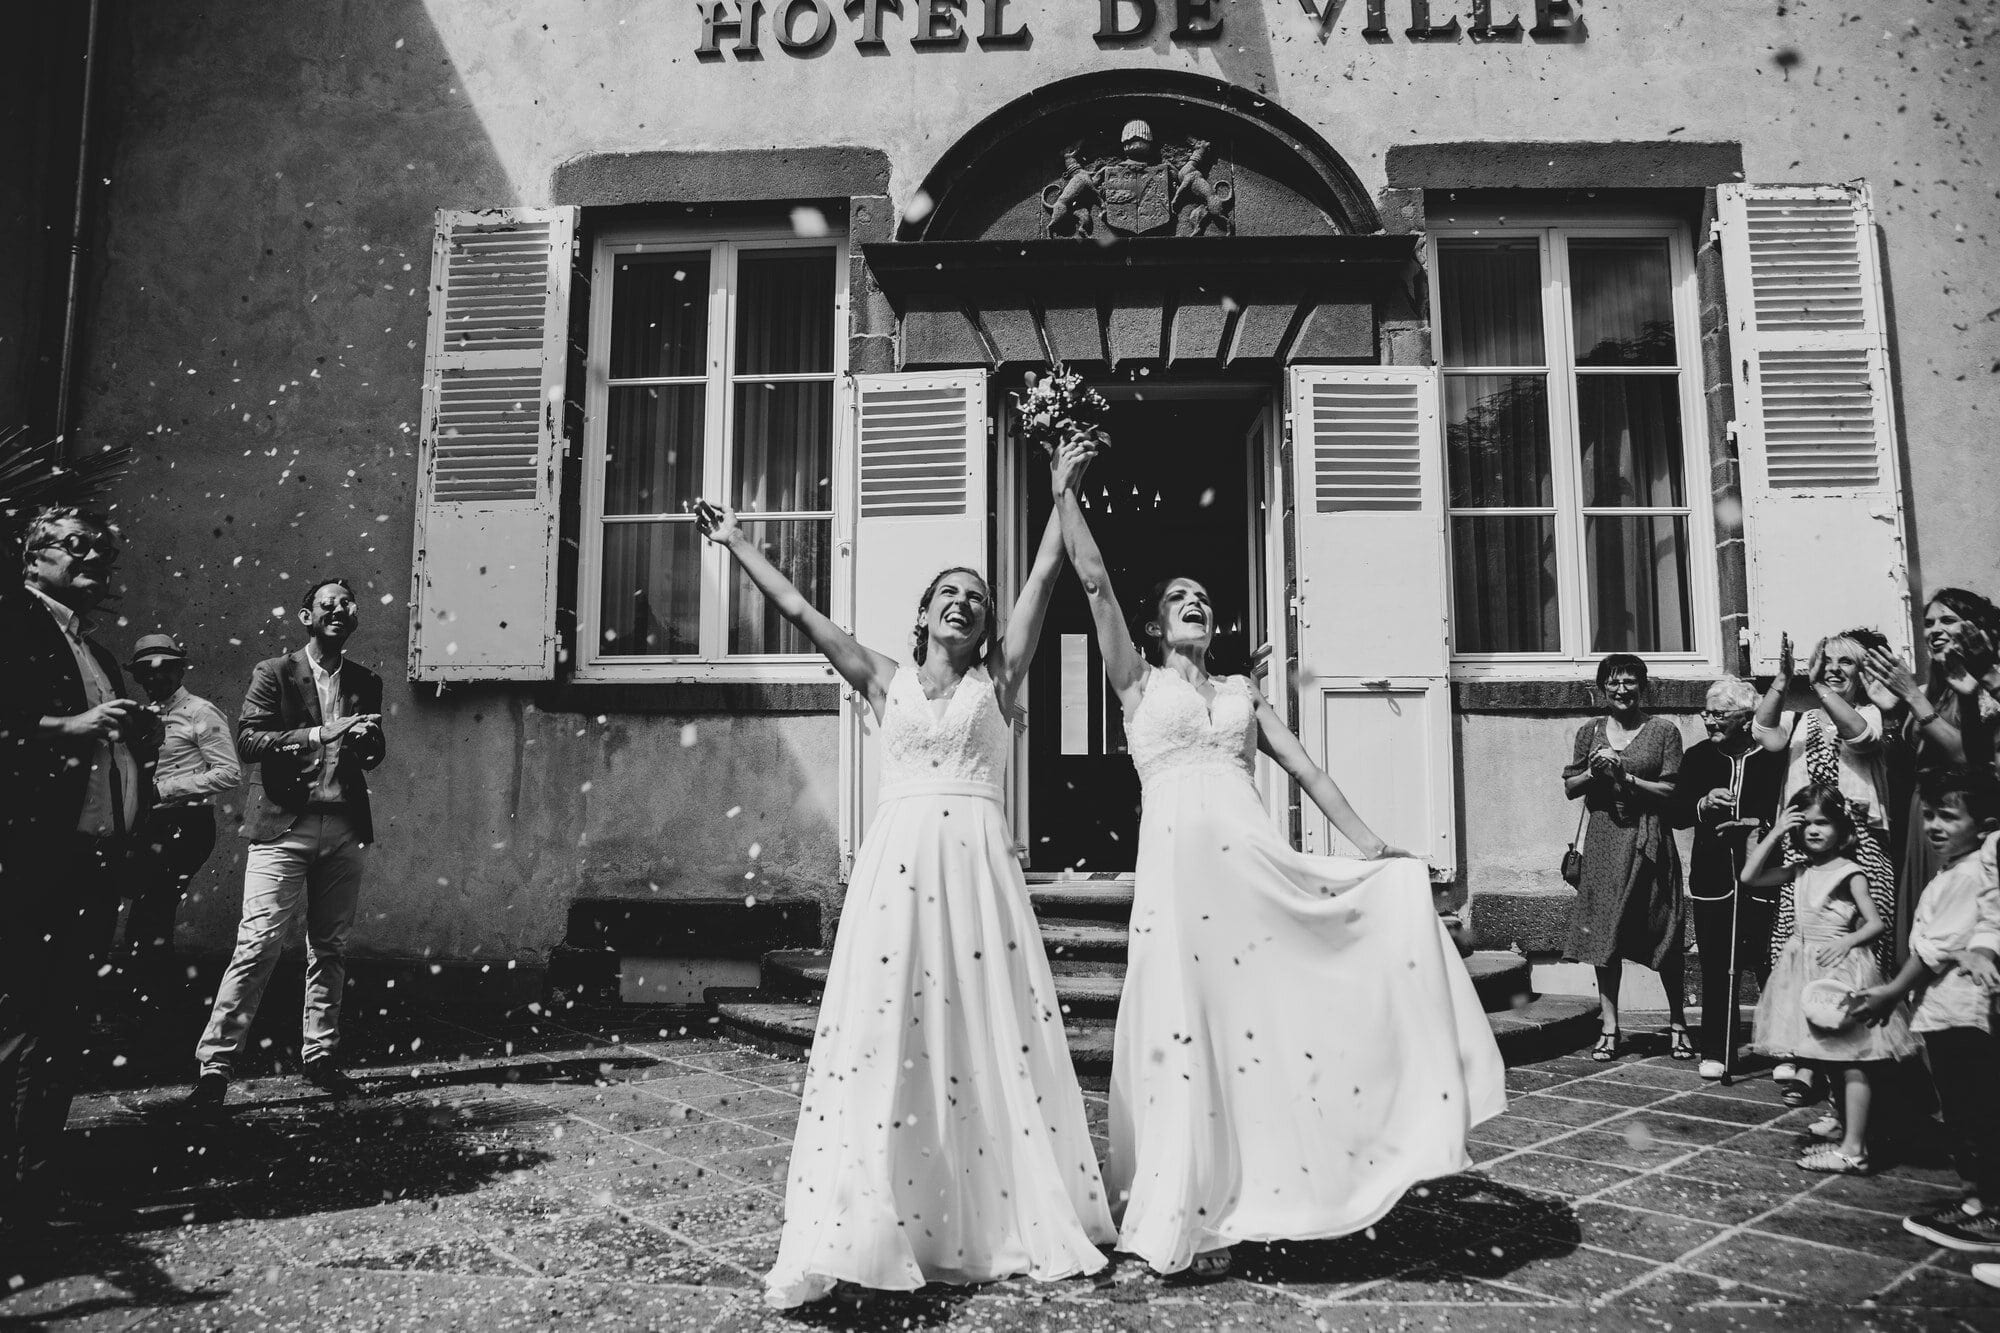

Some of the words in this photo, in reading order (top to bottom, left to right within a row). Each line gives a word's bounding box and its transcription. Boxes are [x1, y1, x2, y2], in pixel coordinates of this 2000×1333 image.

[694, 0, 1034, 62] HOTEL
[1092, 0, 1224, 50] DE
[1299, 0, 1589, 45] VILLE
